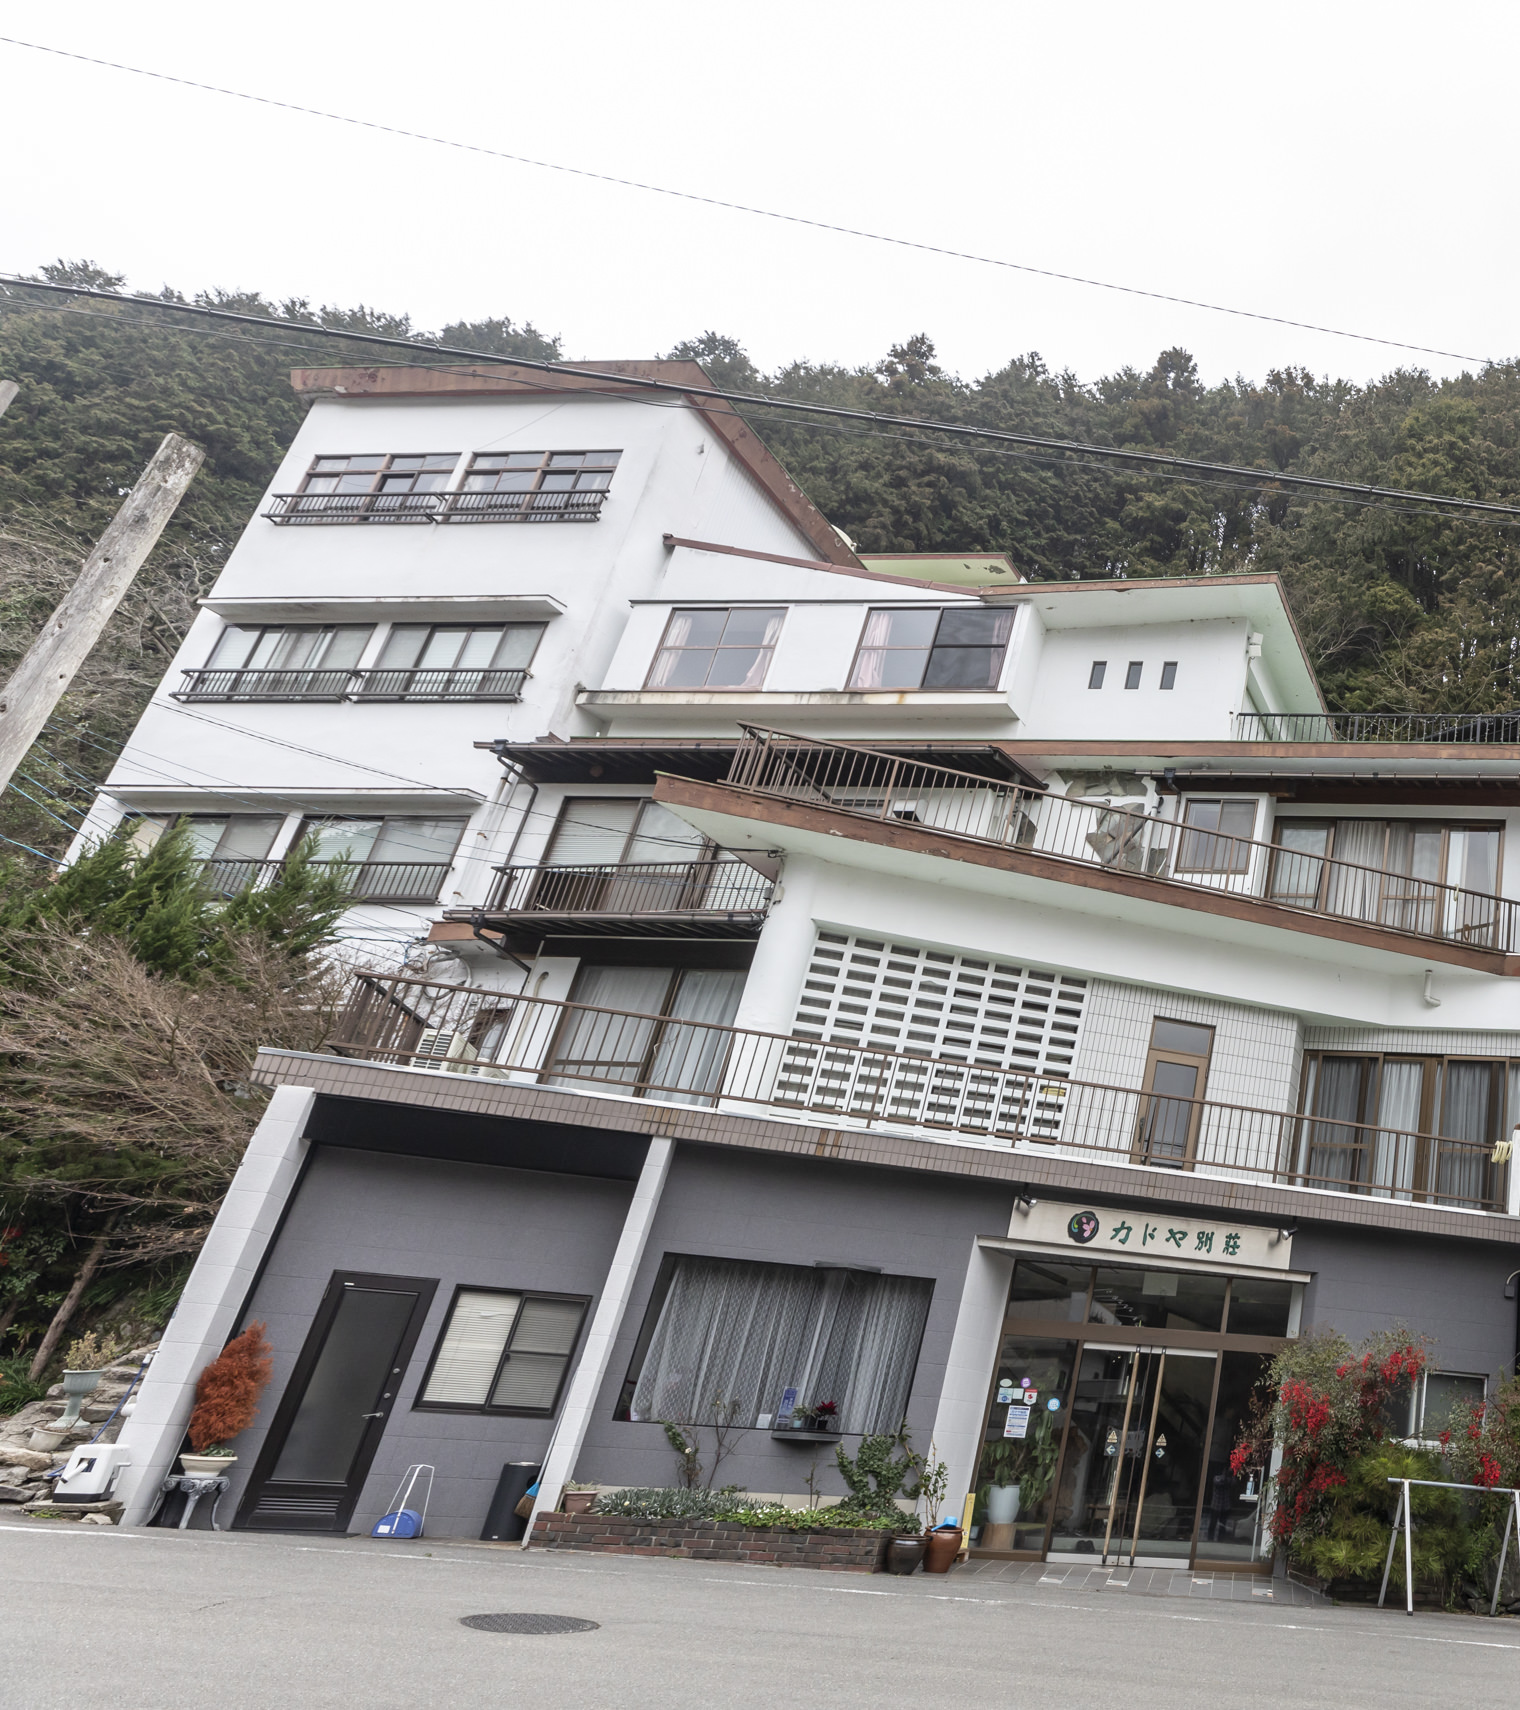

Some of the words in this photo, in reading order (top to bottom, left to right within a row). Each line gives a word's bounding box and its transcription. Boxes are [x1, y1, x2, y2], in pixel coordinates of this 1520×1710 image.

[1110, 1220, 1241, 1255] カドや別荘
